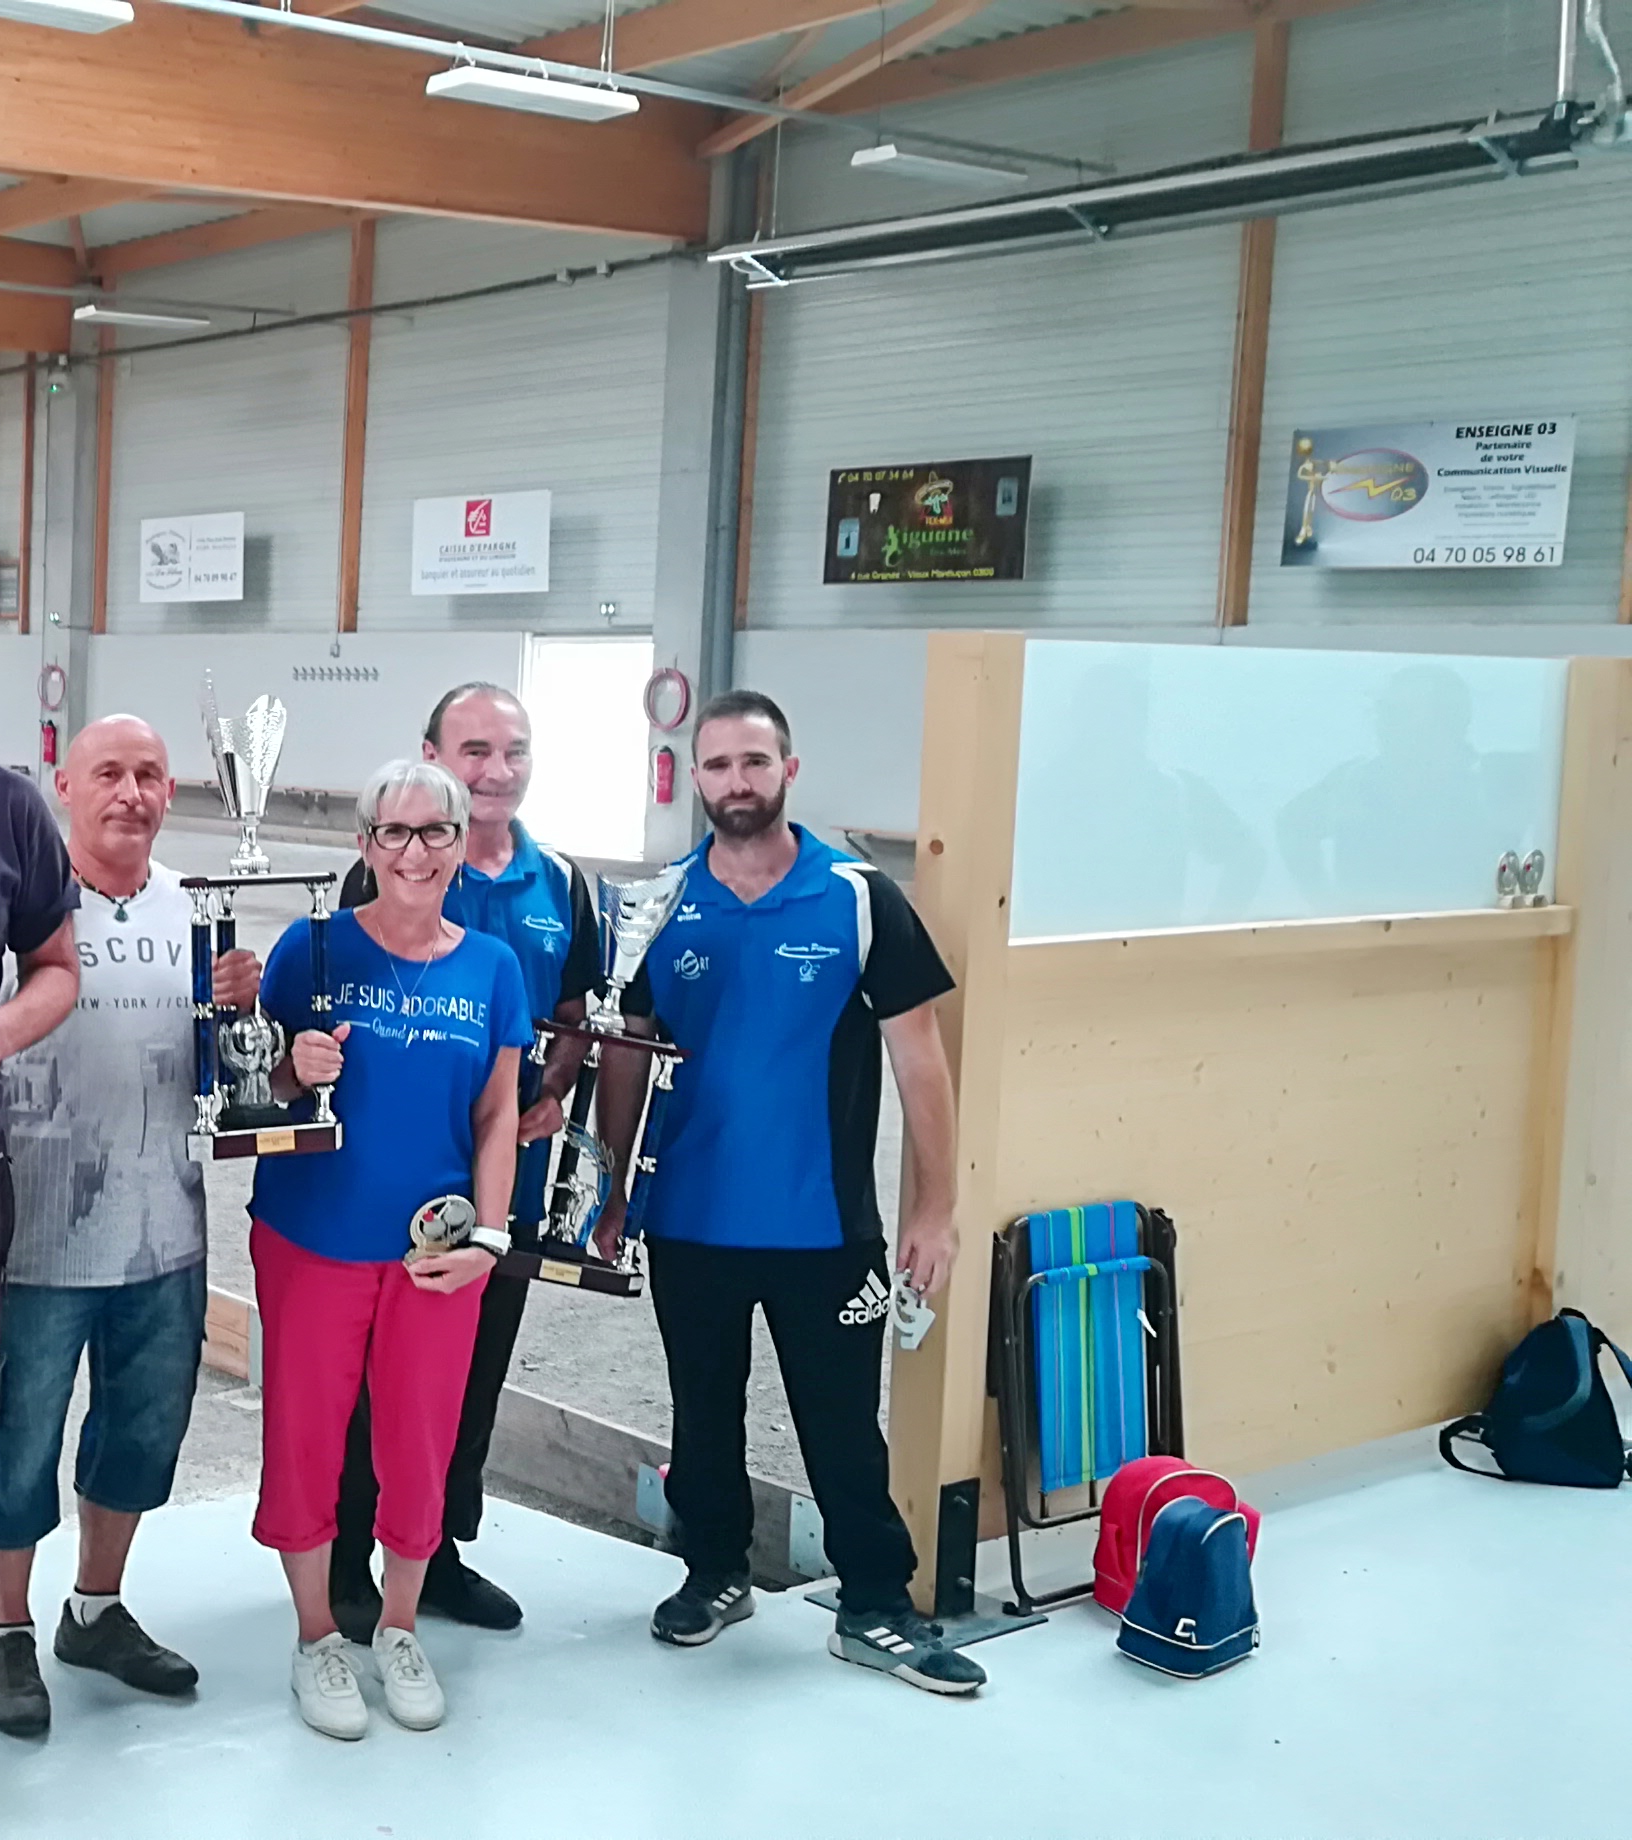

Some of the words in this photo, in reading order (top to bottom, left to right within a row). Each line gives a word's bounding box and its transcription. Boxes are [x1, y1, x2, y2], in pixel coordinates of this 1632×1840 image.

[1455, 423, 1533, 439] ENSEIGNE
[1537, 422, 1557, 435] 03
[1475, 440, 1532, 451] Partenaire
[1480, 454, 1493, 463] de
[1496, 453, 1525, 463] votre
[1437, 466, 1521, 477] Communication
[1524, 463, 1567, 474] Visuelle
[1390, 487, 1417, 501] 03
[439, 545, 467, 554] CAISSE
[469, 541, 517, 552] D'EPARGNE
[1413, 549, 1436, 564] 04
[1444, 548, 1466, 563] 70
[1472, 548, 1496, 563] 05
[1502, 547, 1526, 563] 98
[1533, 547, 1555, 562] 61
[451, 569, 458, 579] et
[491, 569, 500, 577] au
[76, 937, 182, 967] SCOV
[114, 998, 147, 1008] YORK
[335, 983, 354, 1005] JE
[358, 985, 395, 1013] SUIS
[399, 995, 487, 1028] ADORABLE
